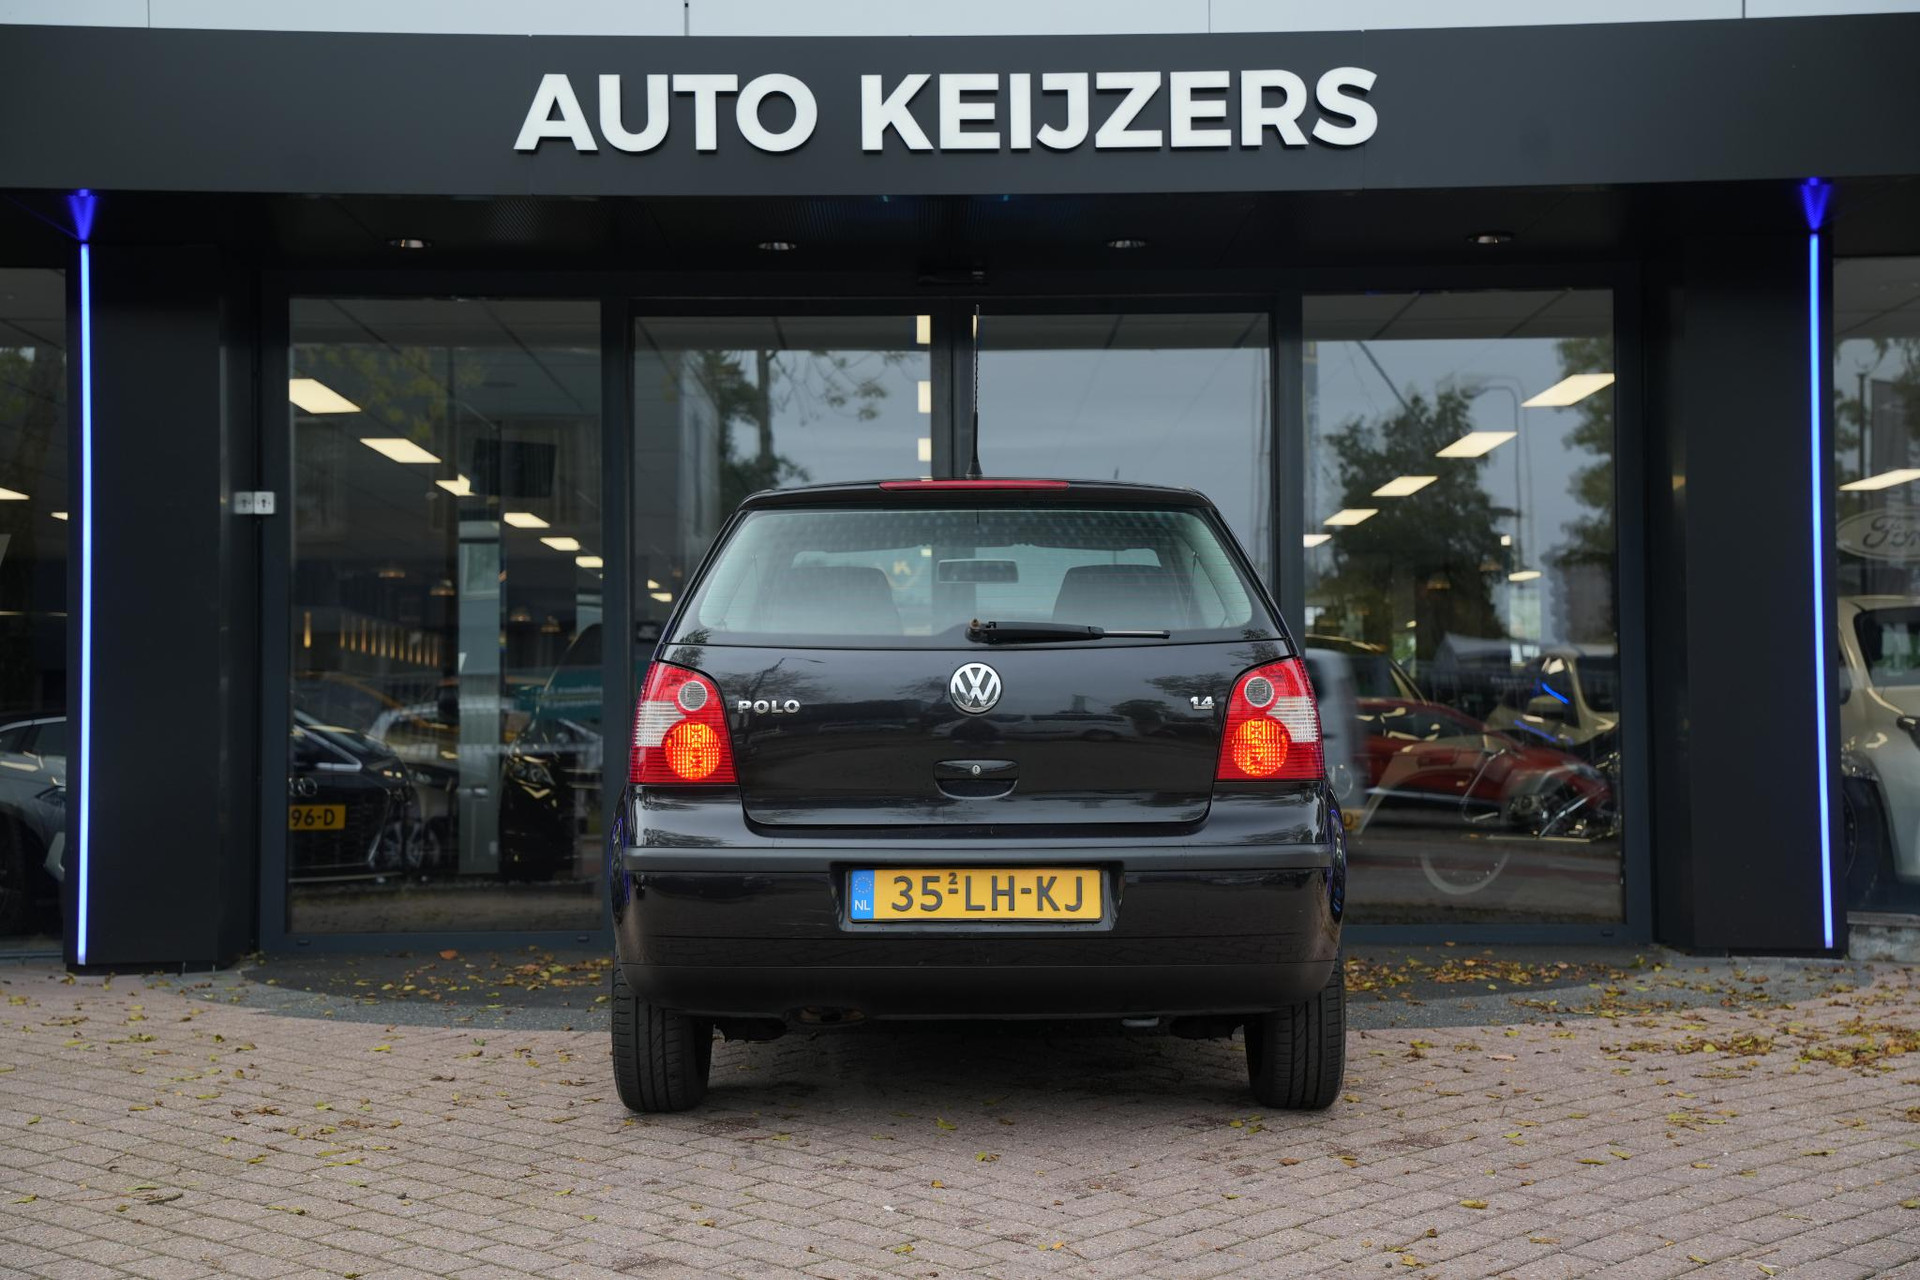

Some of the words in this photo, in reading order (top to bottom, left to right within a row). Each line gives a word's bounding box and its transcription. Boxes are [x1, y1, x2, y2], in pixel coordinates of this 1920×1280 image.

[513, 72, 818, 152] AUTO
[861, 66, 1378, 150] KEIJZERS
[737, 699, 801, 714] POLO
[854, 899, 870, 911] NL
